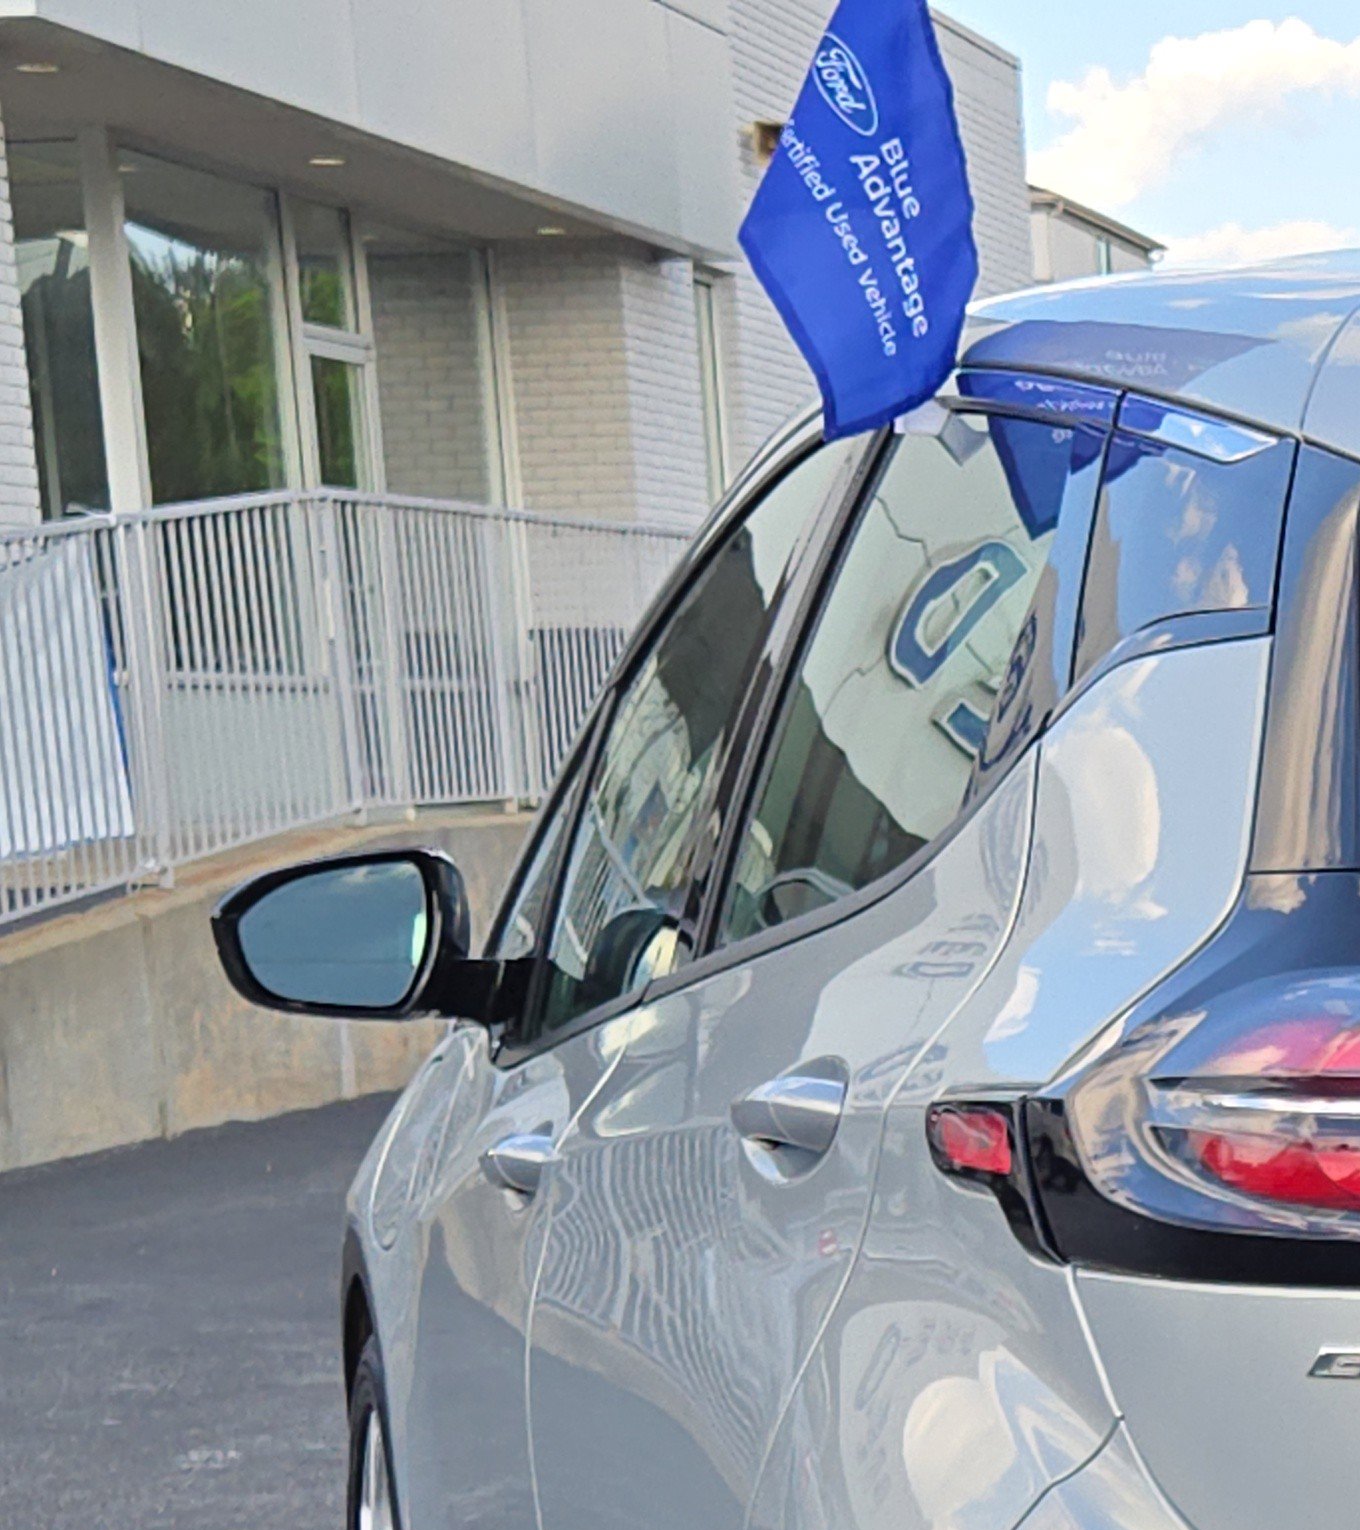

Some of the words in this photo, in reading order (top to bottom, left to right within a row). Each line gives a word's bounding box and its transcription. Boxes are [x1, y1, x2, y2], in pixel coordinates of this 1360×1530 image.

[815, 47, 867, 114] Ford
[781, 119, 836, 201] ertified
[826, 202, 868, 266] Used
[858, 270, 897, 357] Vehicle
[879, 138, 920, 219] Blue
[850, 155, 928, 338] Advantage
